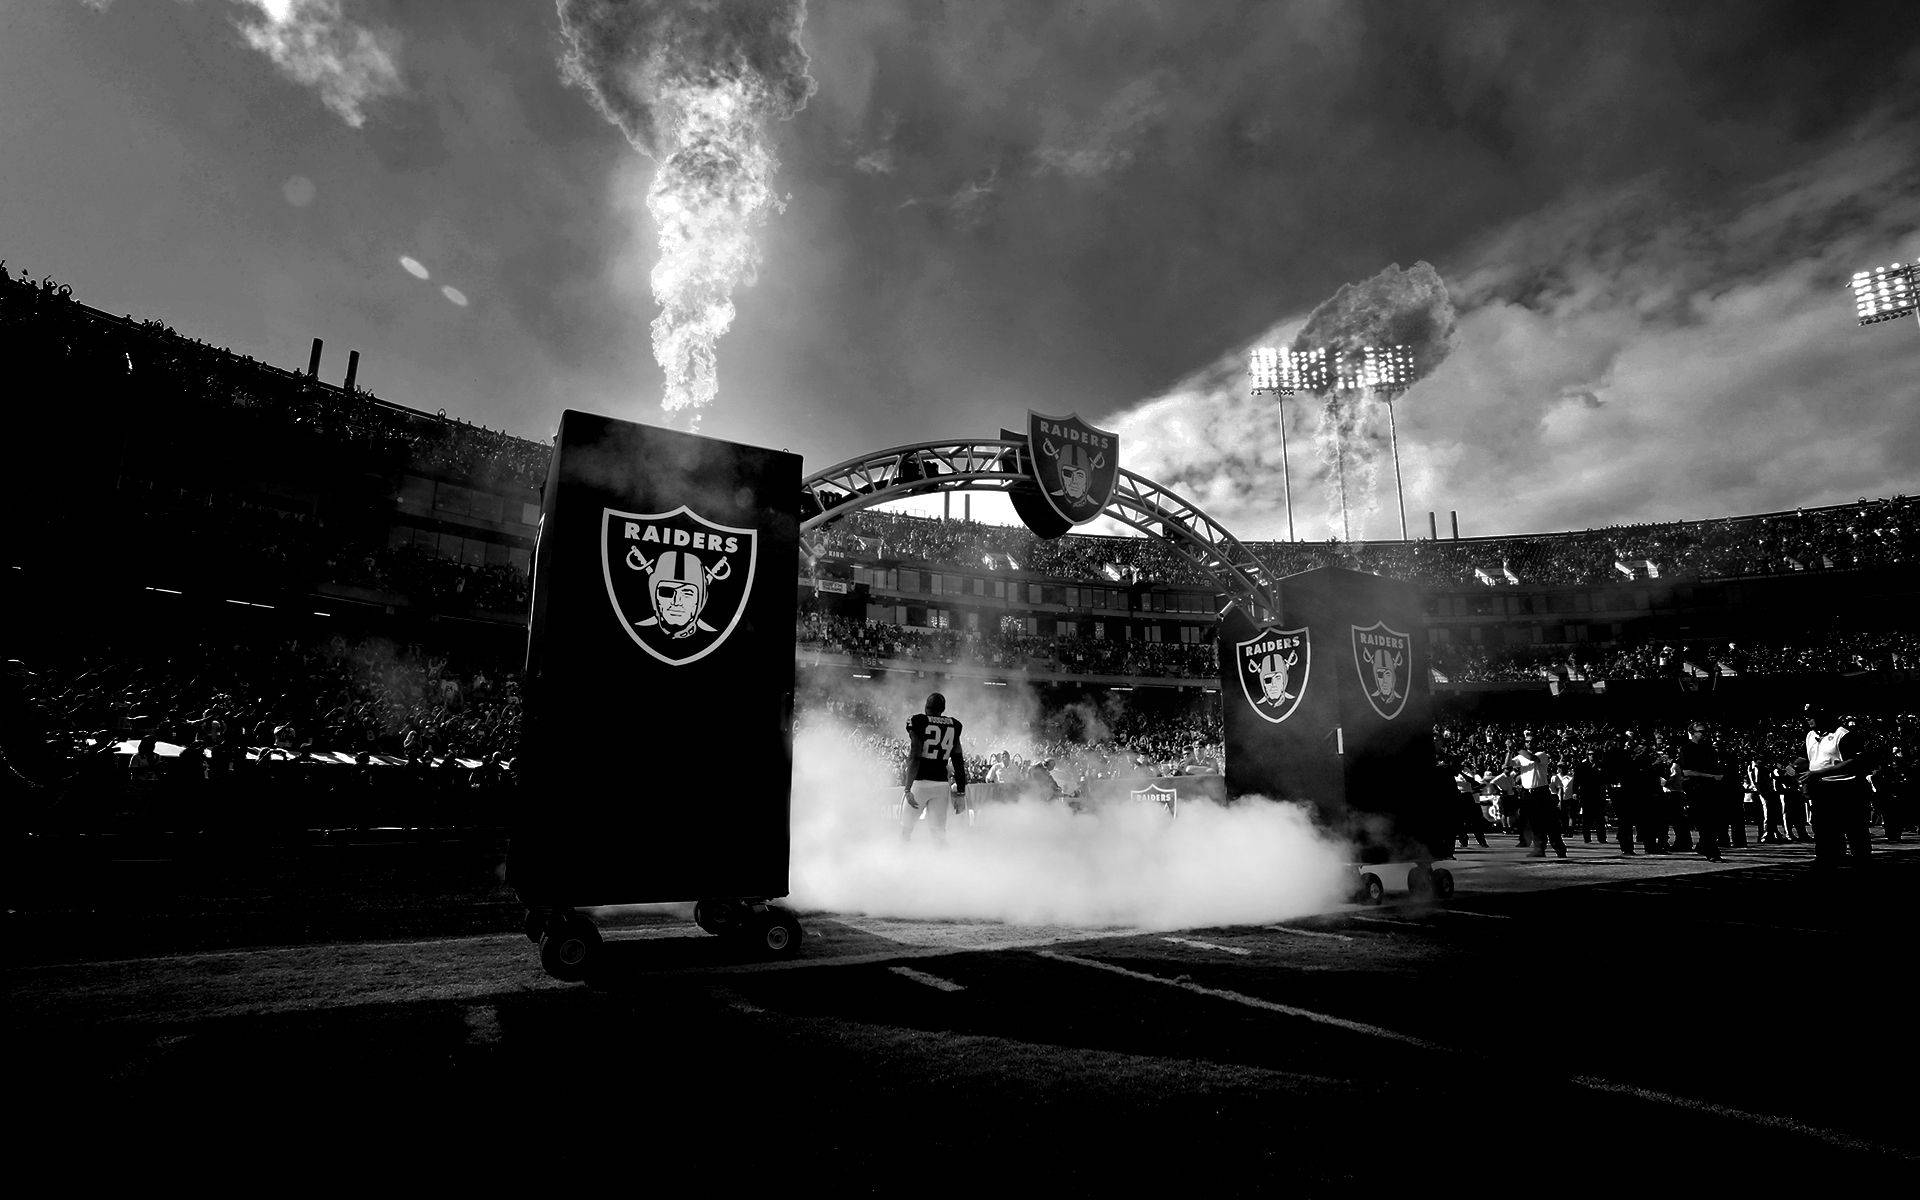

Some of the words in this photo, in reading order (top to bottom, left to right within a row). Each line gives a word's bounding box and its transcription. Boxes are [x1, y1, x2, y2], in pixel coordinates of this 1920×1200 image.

[1040, 420, 1109, 449] RAIDERS
[624, 521, 739, 553] RAIDERS
[1246, 636, 1301, 657] RAIDERS
[1360, 633, 1404, 649] RAIDERS
[921, 724, 955, 760] 24
[1136, 793, 1171, 802] RAIDERS
